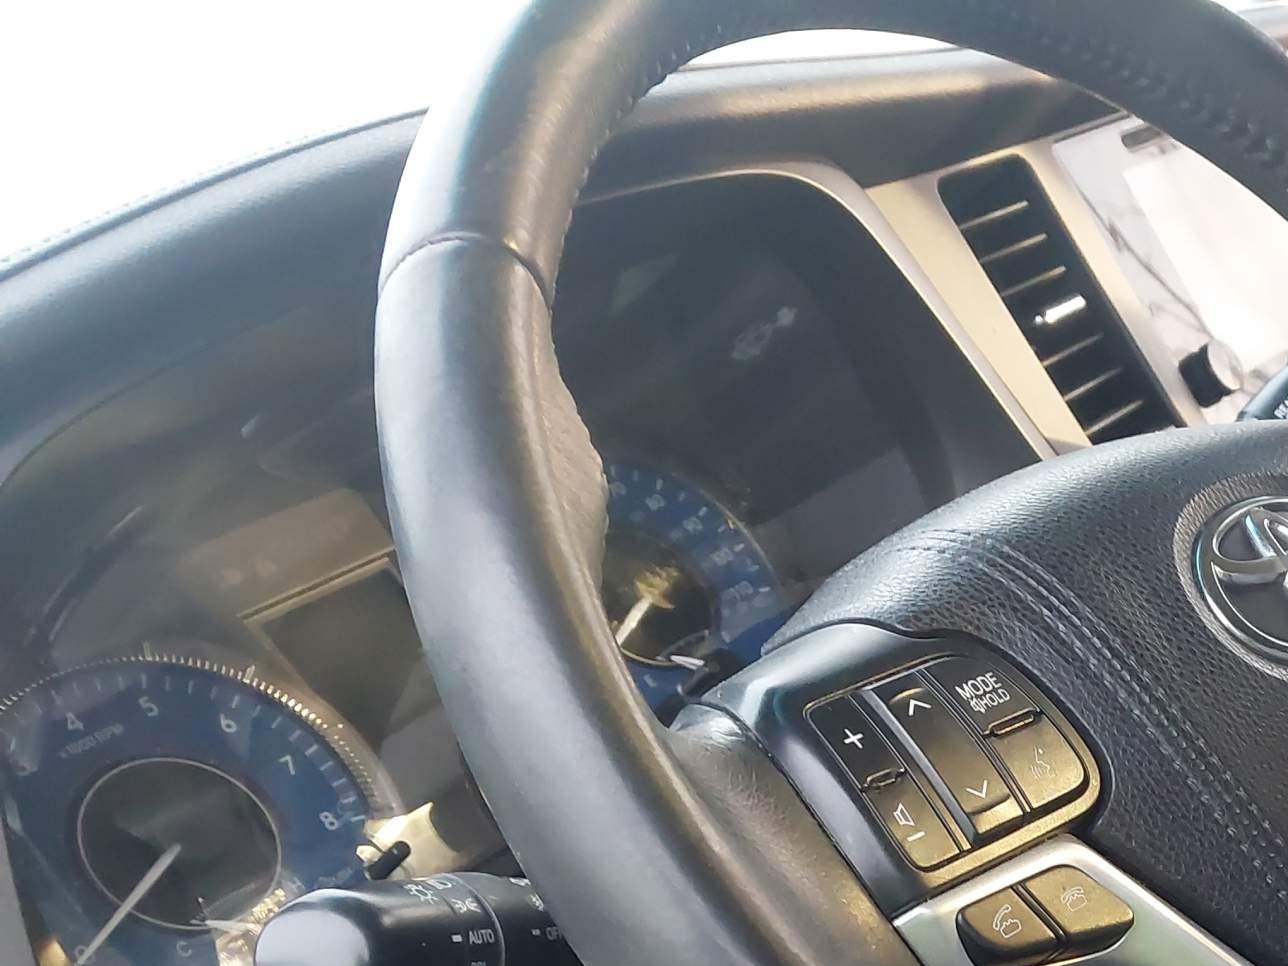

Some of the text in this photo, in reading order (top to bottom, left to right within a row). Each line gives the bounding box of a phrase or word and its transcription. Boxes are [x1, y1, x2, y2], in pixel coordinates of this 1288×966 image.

[955, 671, 1002, 702] MODE
[138, 696, 159, 717] 5
[978, 688, 1010, 710] HOLD
[66, 712, 84, 731] 4
[220, 713, 238, 733] 6
[279, 754, 296, 776] 7
[319, 811, 340, 831] 8
[468, 928, 495, 945] AUTO
